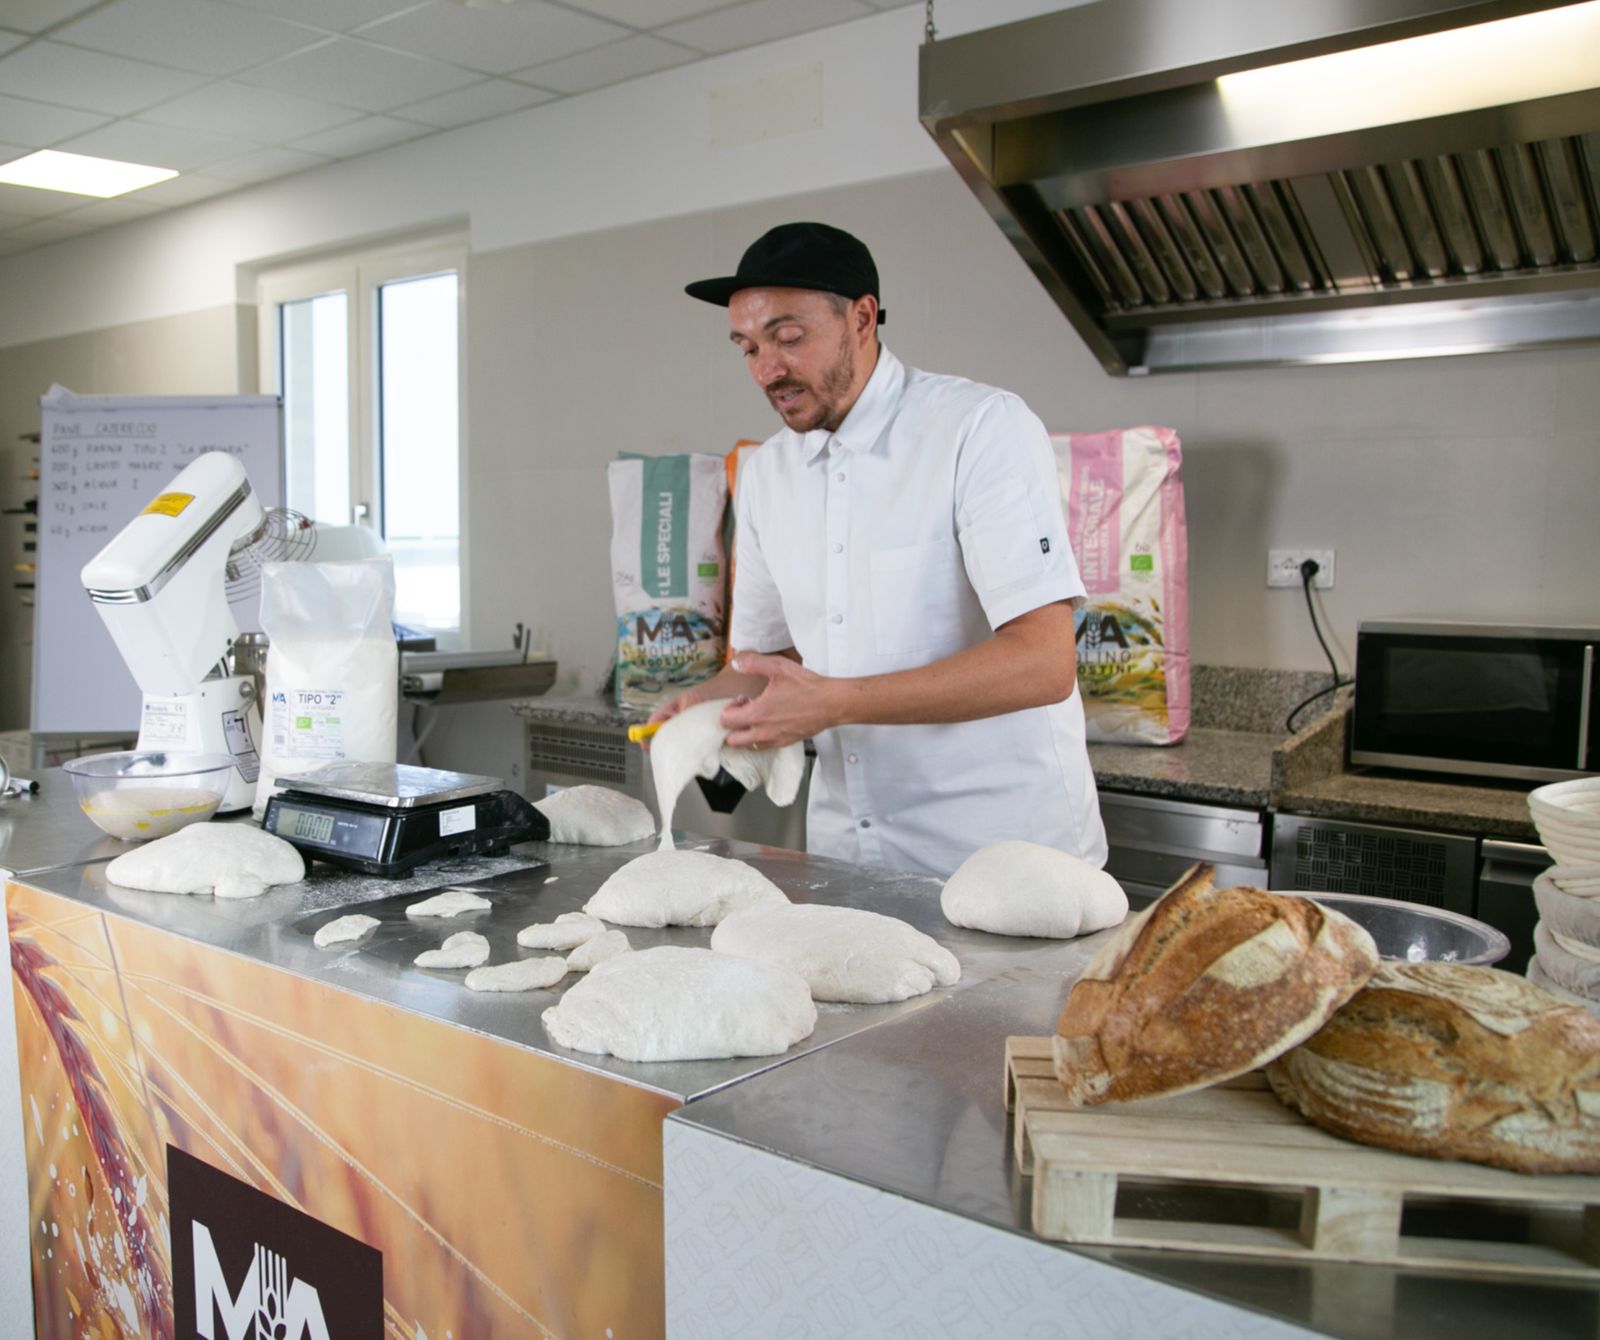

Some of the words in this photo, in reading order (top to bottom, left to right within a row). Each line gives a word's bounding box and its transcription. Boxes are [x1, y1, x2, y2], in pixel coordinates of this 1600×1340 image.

[657, 491, 673, 564] SPECIALI
[1082, 478, 1105, 581] INTEGRALE
[657, 566, 671, 588] LE
[636, 613, 696, 646] MA
[1077, 649, 1133, 665] LINO
[1077, 664, 1133, 675] OSTINI
[299, 693, 322, 705] TIPO
[324, 694, 342, 705] "2"
